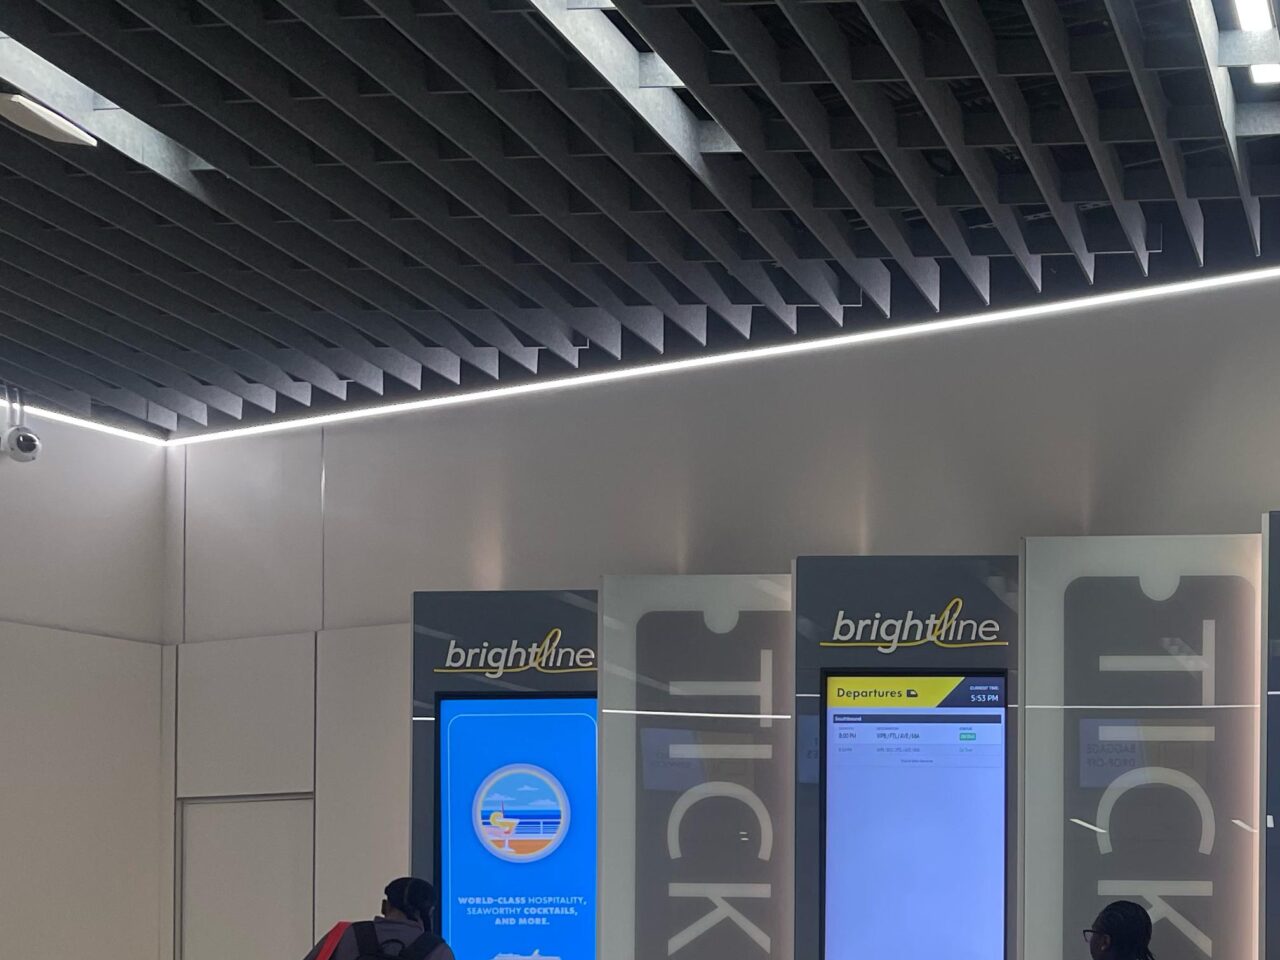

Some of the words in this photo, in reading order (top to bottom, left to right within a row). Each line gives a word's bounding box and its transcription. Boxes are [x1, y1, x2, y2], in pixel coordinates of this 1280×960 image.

[833, 598, 1000, 653] brightline
[445, 628, 596, 678] brightline
[836, 687, 903, 701] Departures
[970, 694, 986, 702] 5:53
[457, 896, 526, 905] WORLD-CLASS
[528, 896, 587, 906] HOSPITALITY,
[466, 907, 521, 915] SEAWORTHY
[523, 906, 578, 916] COCKTAILS,
[494, 917, 516, 926] AND
[518, 917, 550, 926] MORE.
